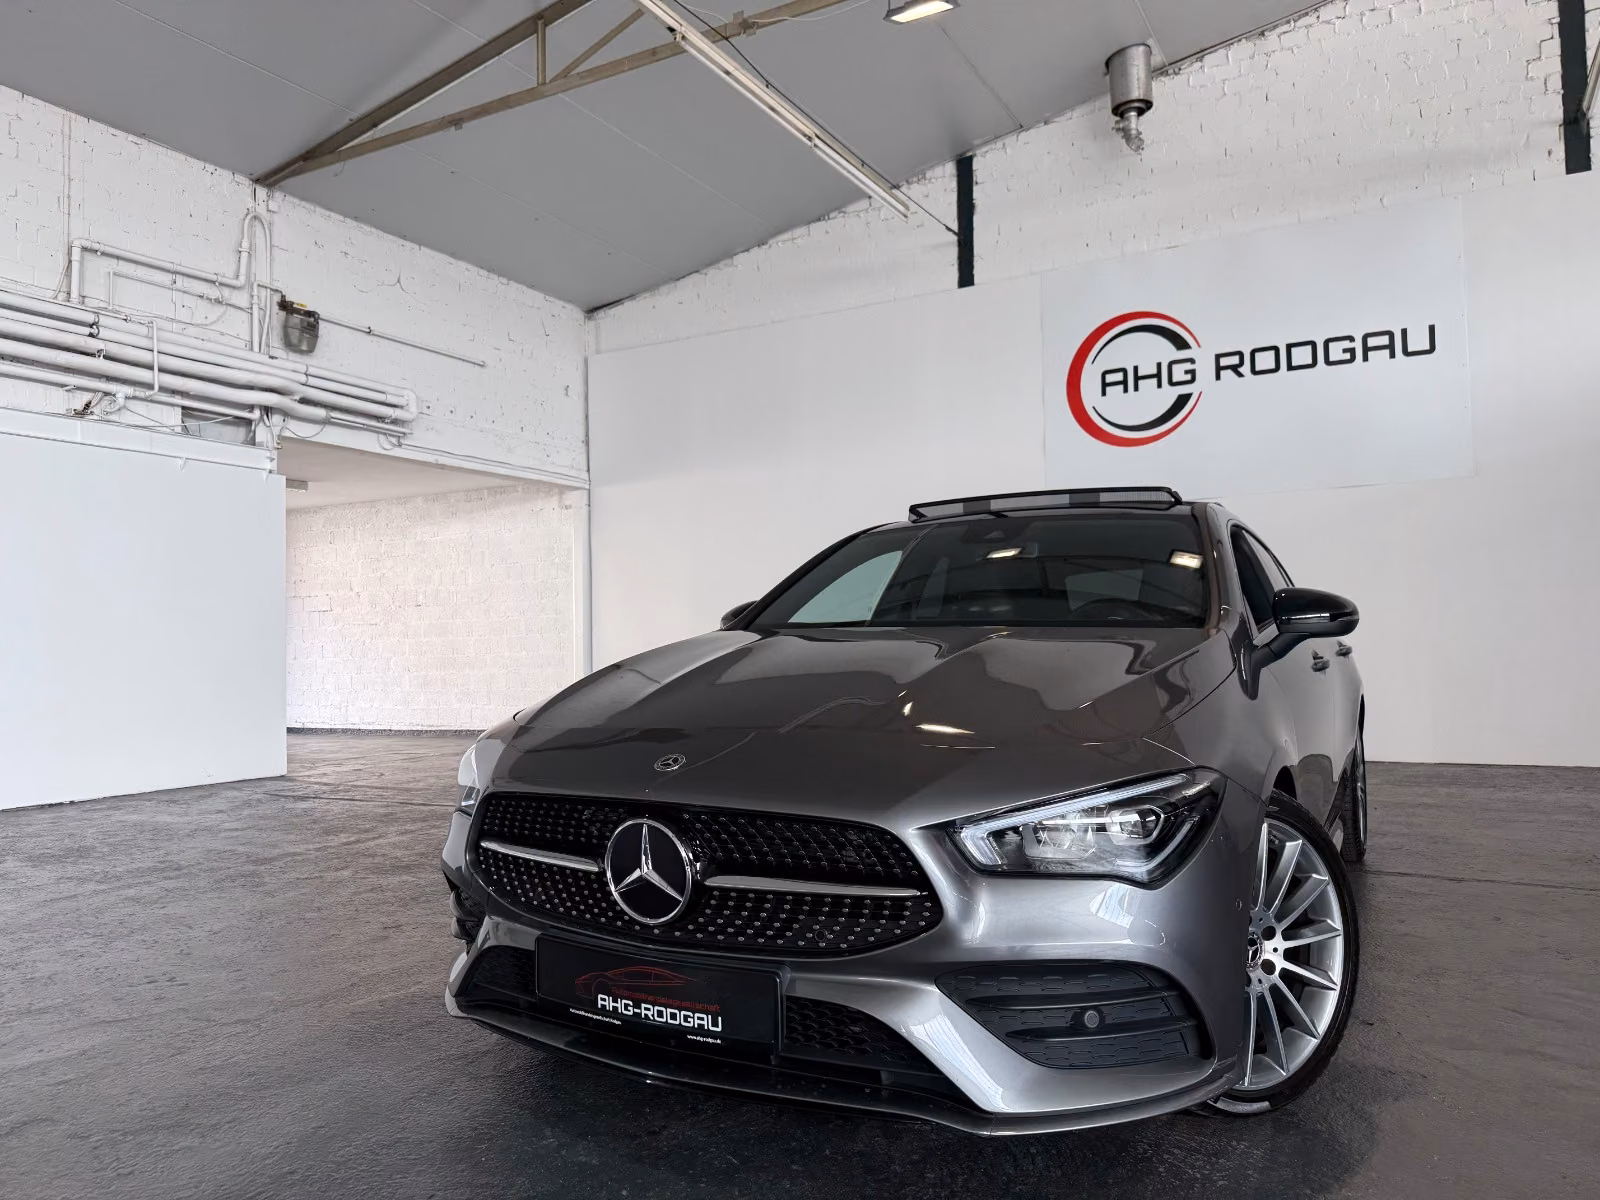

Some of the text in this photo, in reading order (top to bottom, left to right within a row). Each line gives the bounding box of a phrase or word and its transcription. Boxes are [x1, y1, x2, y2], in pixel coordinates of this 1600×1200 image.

[1100, 324, 1437, 397] AHG RODGAU
[597, 993, 722, 1032] AHG-RODGAU
